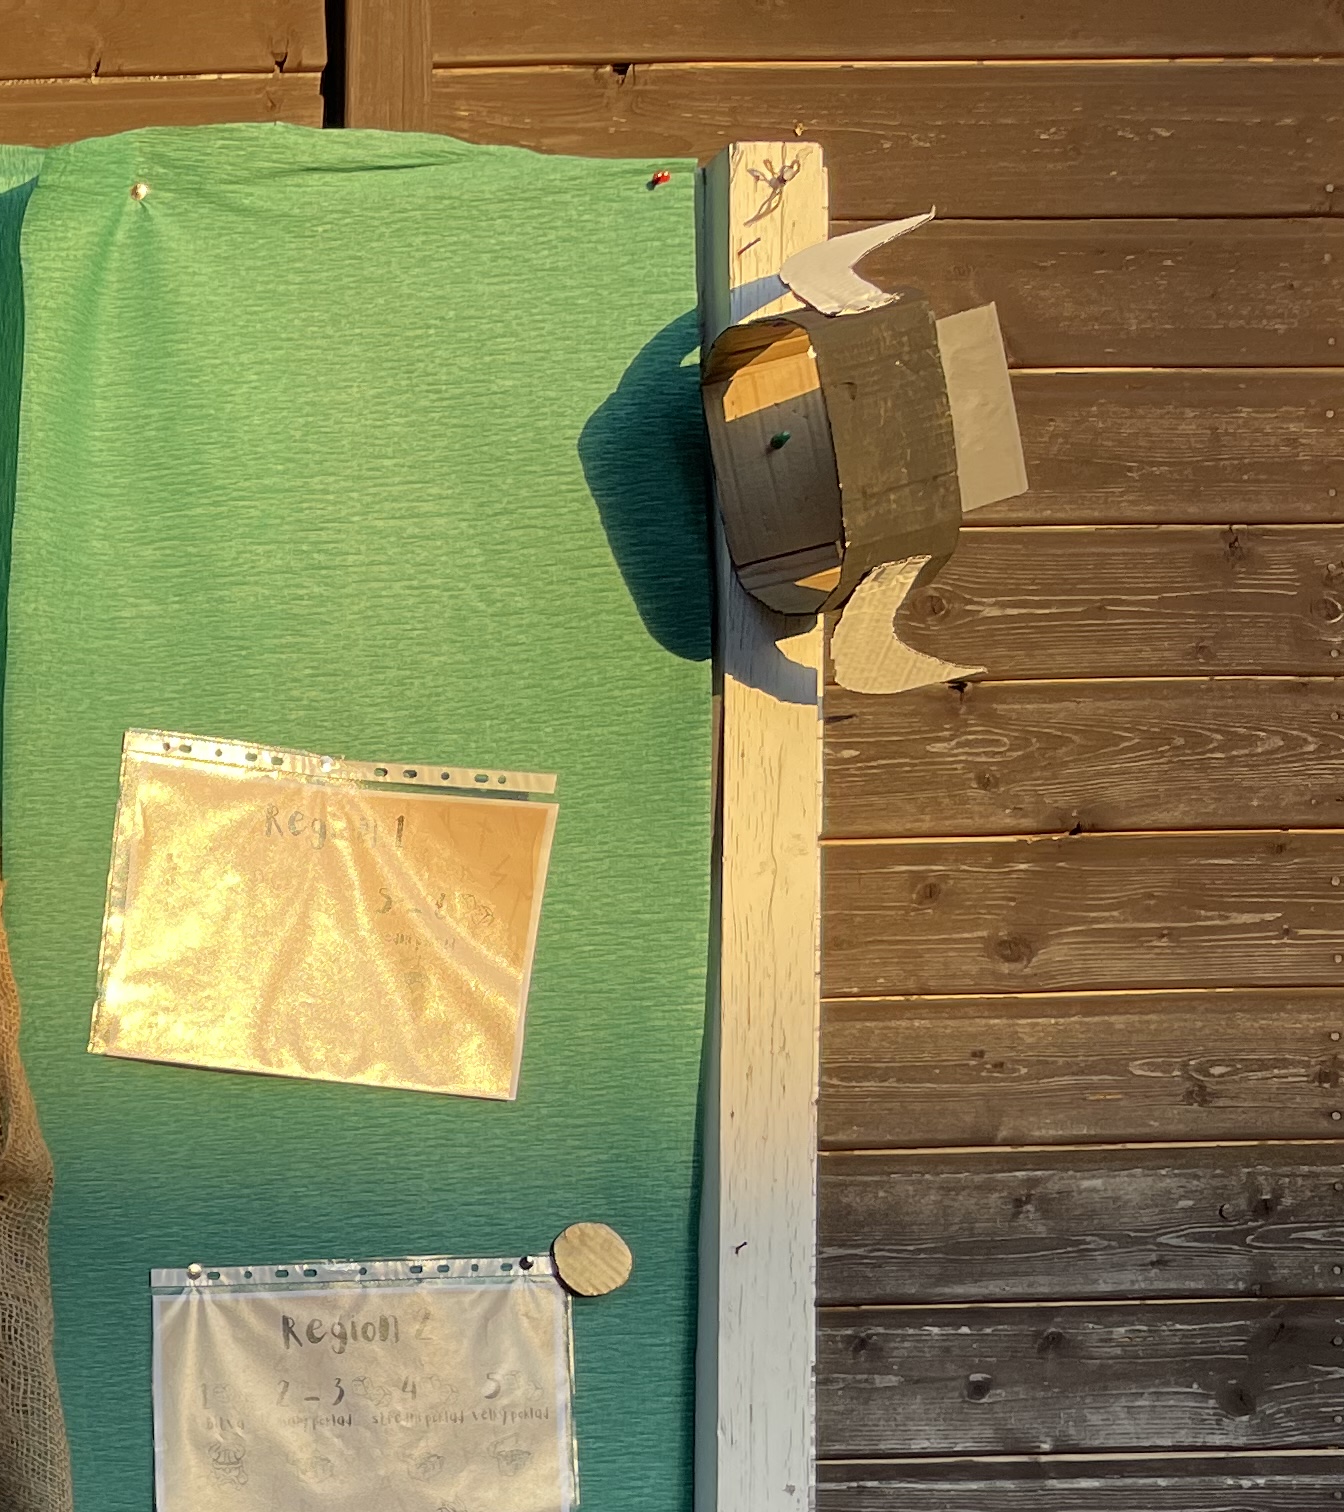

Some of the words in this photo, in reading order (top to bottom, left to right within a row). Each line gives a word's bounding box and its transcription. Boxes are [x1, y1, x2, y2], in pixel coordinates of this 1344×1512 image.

[282, 1313, 399, 1354] Region
[415, 1307, 433, 1341] 2
[276, 1379, 290, 1407] 2
[332, 1377, 345, 1406] 3
[402, 1374, 417, 1399] 4
[484, 1371, 501, 1399] 5
[425, 1410, 464, 1428] poklad
[512, 1407, 549, 1423] poklad
